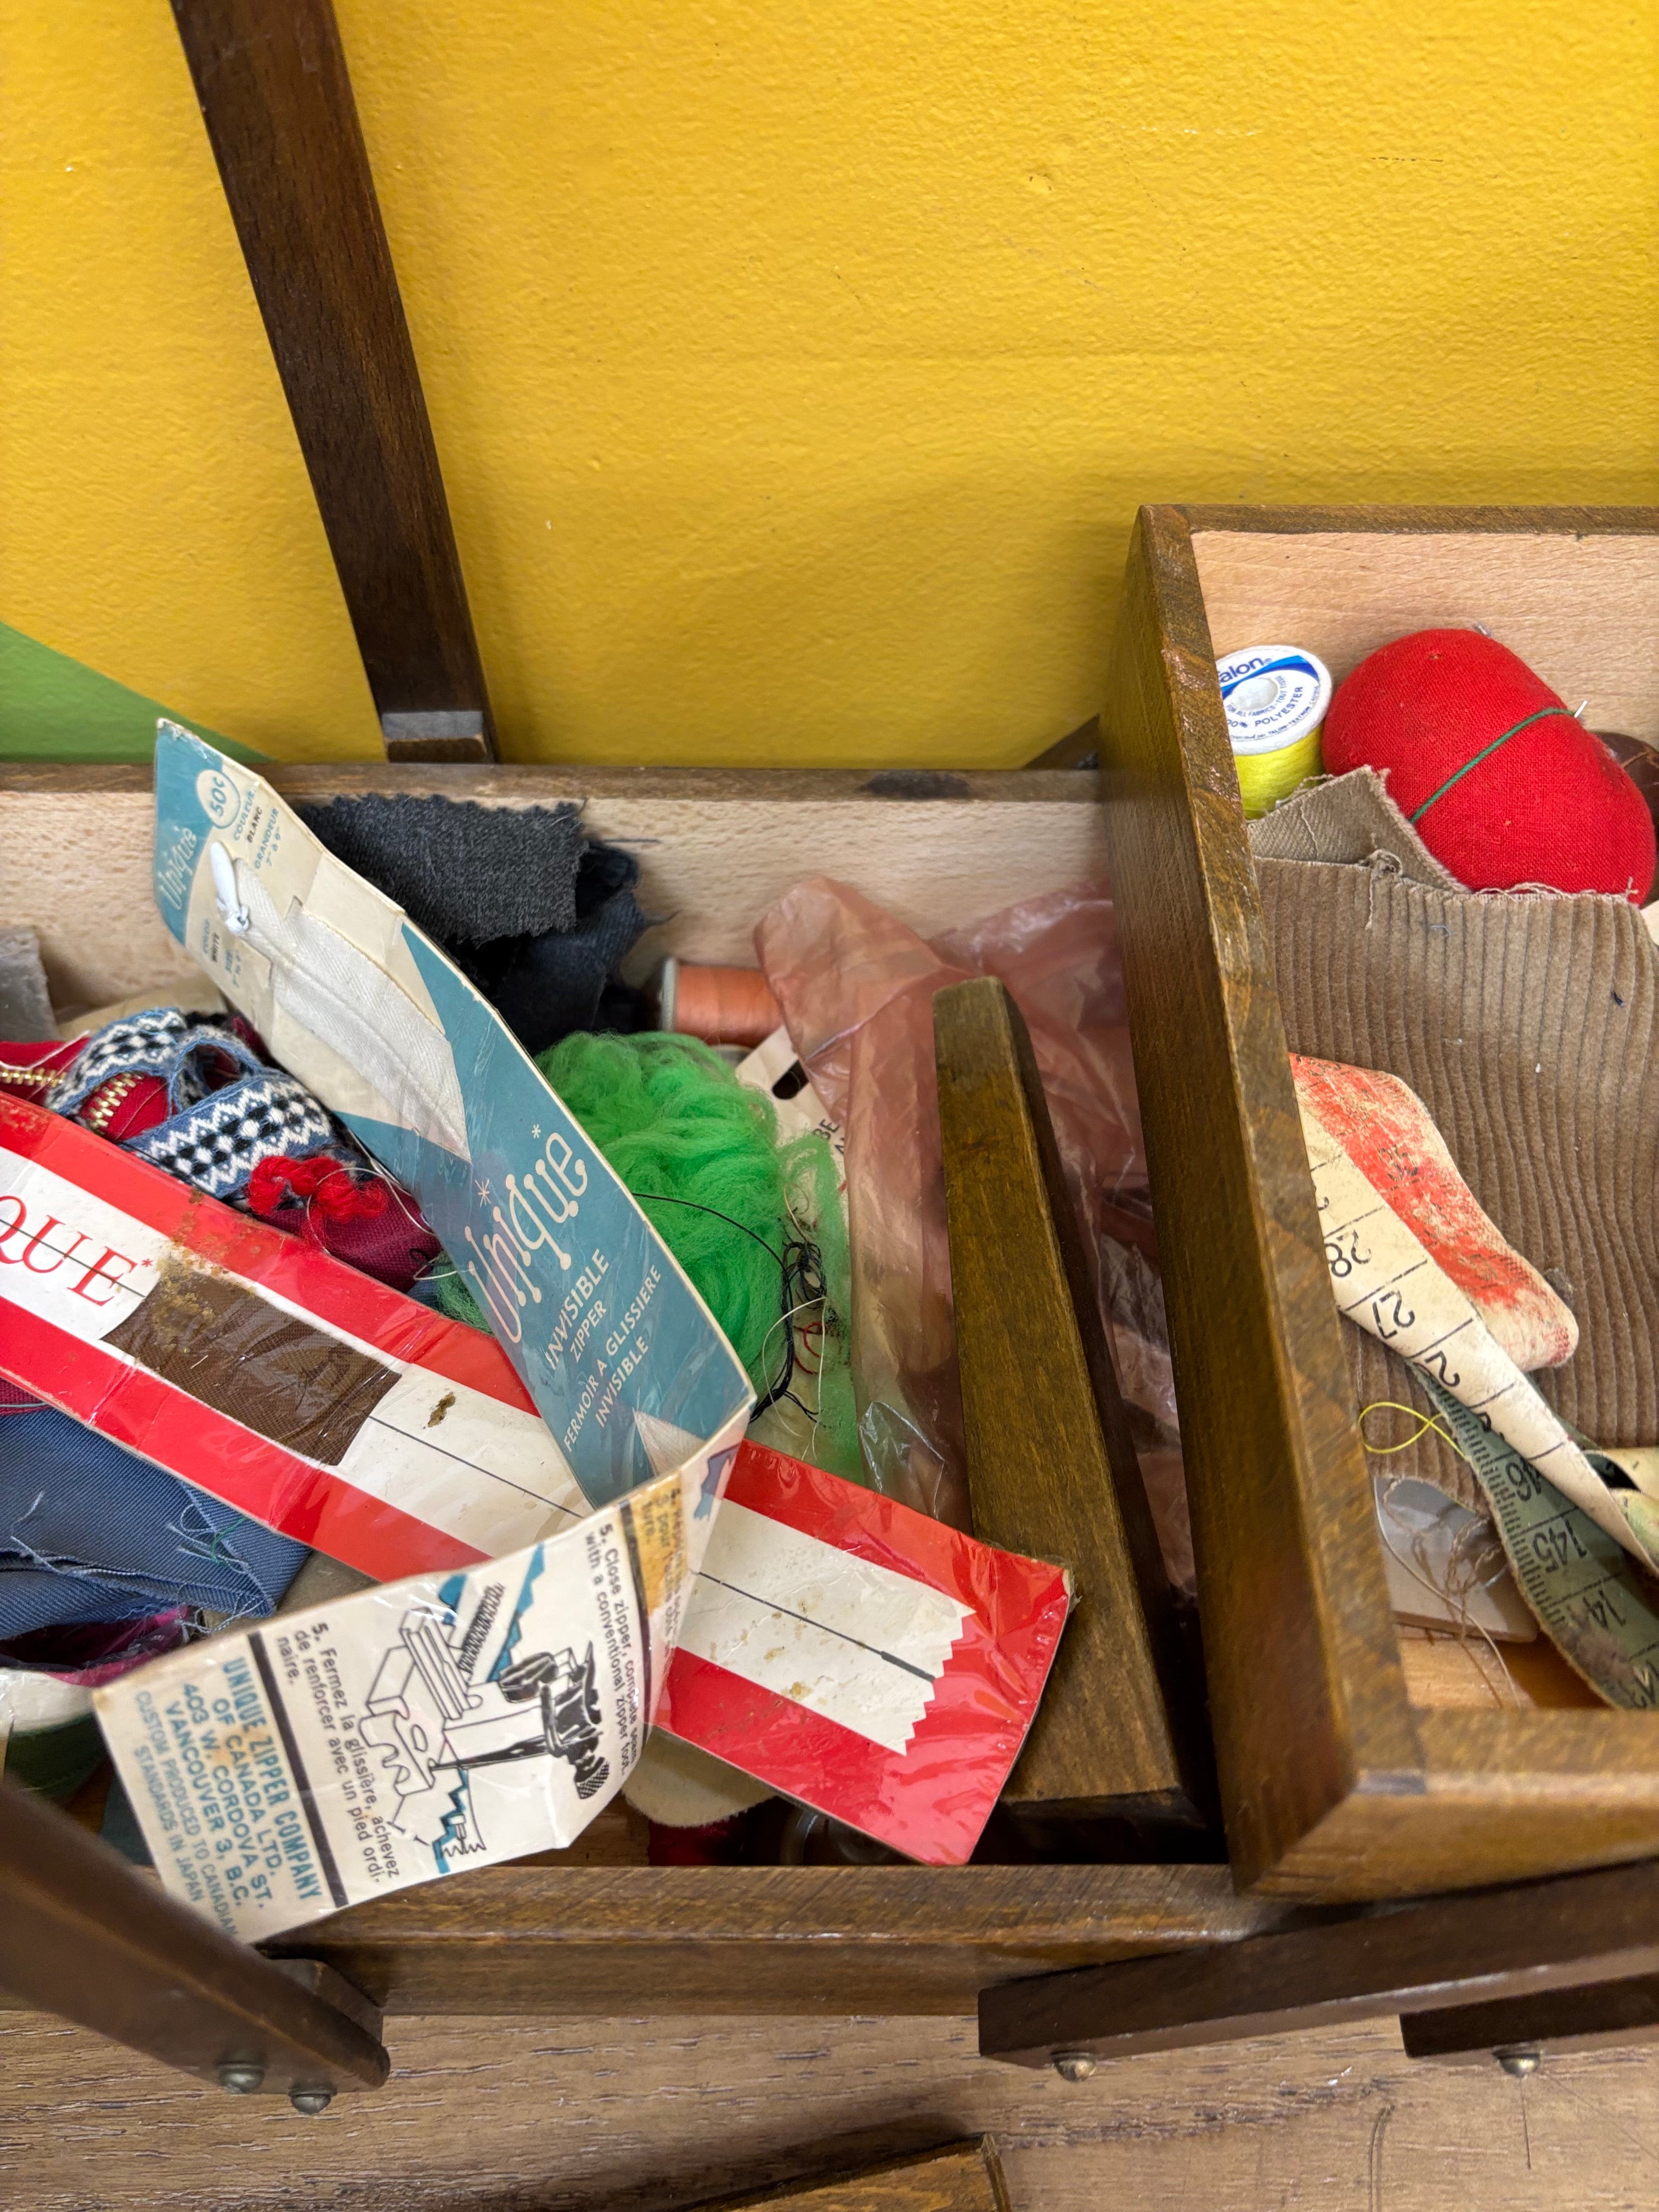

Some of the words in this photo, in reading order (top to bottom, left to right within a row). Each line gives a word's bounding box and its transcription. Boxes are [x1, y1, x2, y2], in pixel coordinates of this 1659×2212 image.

[1218, 657, 1264, 683] alon
[1227, 719, 1248, 728] 00%
[1255, 686, 1304, 727] POLYESTER
[233, 790, 255, 840] COULEUR
[246, 806, 263, 843] BLANC
[255, 807, 279, 869] GRANDEUR
[158, 827, 197, 911] Unique
[465, 1132, 588, 1344] Unique
[544, 1249, 610, 1371] INVISIBLE
[570, 1299, 607, 1364] ZIPPER
[1372, 1290, 1416, 1340] 27
[563, 1374, 599, 1453] FERMOIR
[596, 1358, 608, 1378] A
[605, 1264, 662, 1358] GLISSIERE
[595, 1335, 649, 1429] INVISIBLE
[1421, 1350, 1460, 1387] 2
[585, 1533, 601, 1568] with
[599, 1523, 613, 1543] 5.
[1534, 1515, 1587, 1573] 145
[592, 1575, 604, 1584] a
[603, 1548, 622, 1593] Close
[294, 1630, 311, 1651] de
[312, 1622, 329, 1642] 5.
[596, 1590, 624, 1692] conventional
[613, 1598, 633, 1657] zipper,
[277, 1636, 300, 1685] naire.
[320, 1648, 349, 1708] Fermez
[303, 1657, 337, 1731] renforcer
[614, 1695, 629, 1742] zipper
[624, 1660, 640, 1724] complete
[134, 1690, 171, 1756] CUSTOM
[342, 1714, 356, 1730] la
[223, 1657, 267, 1734] UNIQUE
[248, 1735, 291, 1807] ZIPPER
[274, 1810, 323, 1900] COMPANY
[328, 1739, 349, 1774] avec
[345, 1739, 377, 1810] glissière,
[619, 1745, 628, 1776] foot.
[134, 1745, 178, 1830] STANDARDS
[163, 1759, 201, 1836] PRODUCED
[165, 1701, 224, 1831] VANCOUVER
[216, 1838, 232, 1861] 3,
[225, 1865, 249, 1906] B.C.
[182, 1683, 209, 1724] 403
[200, 1730, 219, 1759] W.
[212, 1765, 259, 1866] CORDOVA
[251, 1873, 272, 1908] ST.
[212, 1698, 235, 1724] OF
[225, 1735, 266, 1822] CANADA
[257, 1829, 282, 1876] LTD.
[342, 1781, 357, 1801] un
[168, 1834, 186, 1851] IN
[192, 1840, 210, 1860] TO
[347, 1808, 370, 1842] pied
[371, 1816, 400, 1878] achevez
[176, 1855, 205, 1901] JAPAN
[363, 1847, 380, 1882] ordi-
[200, 1865, 238, 1935] CANADIAN
